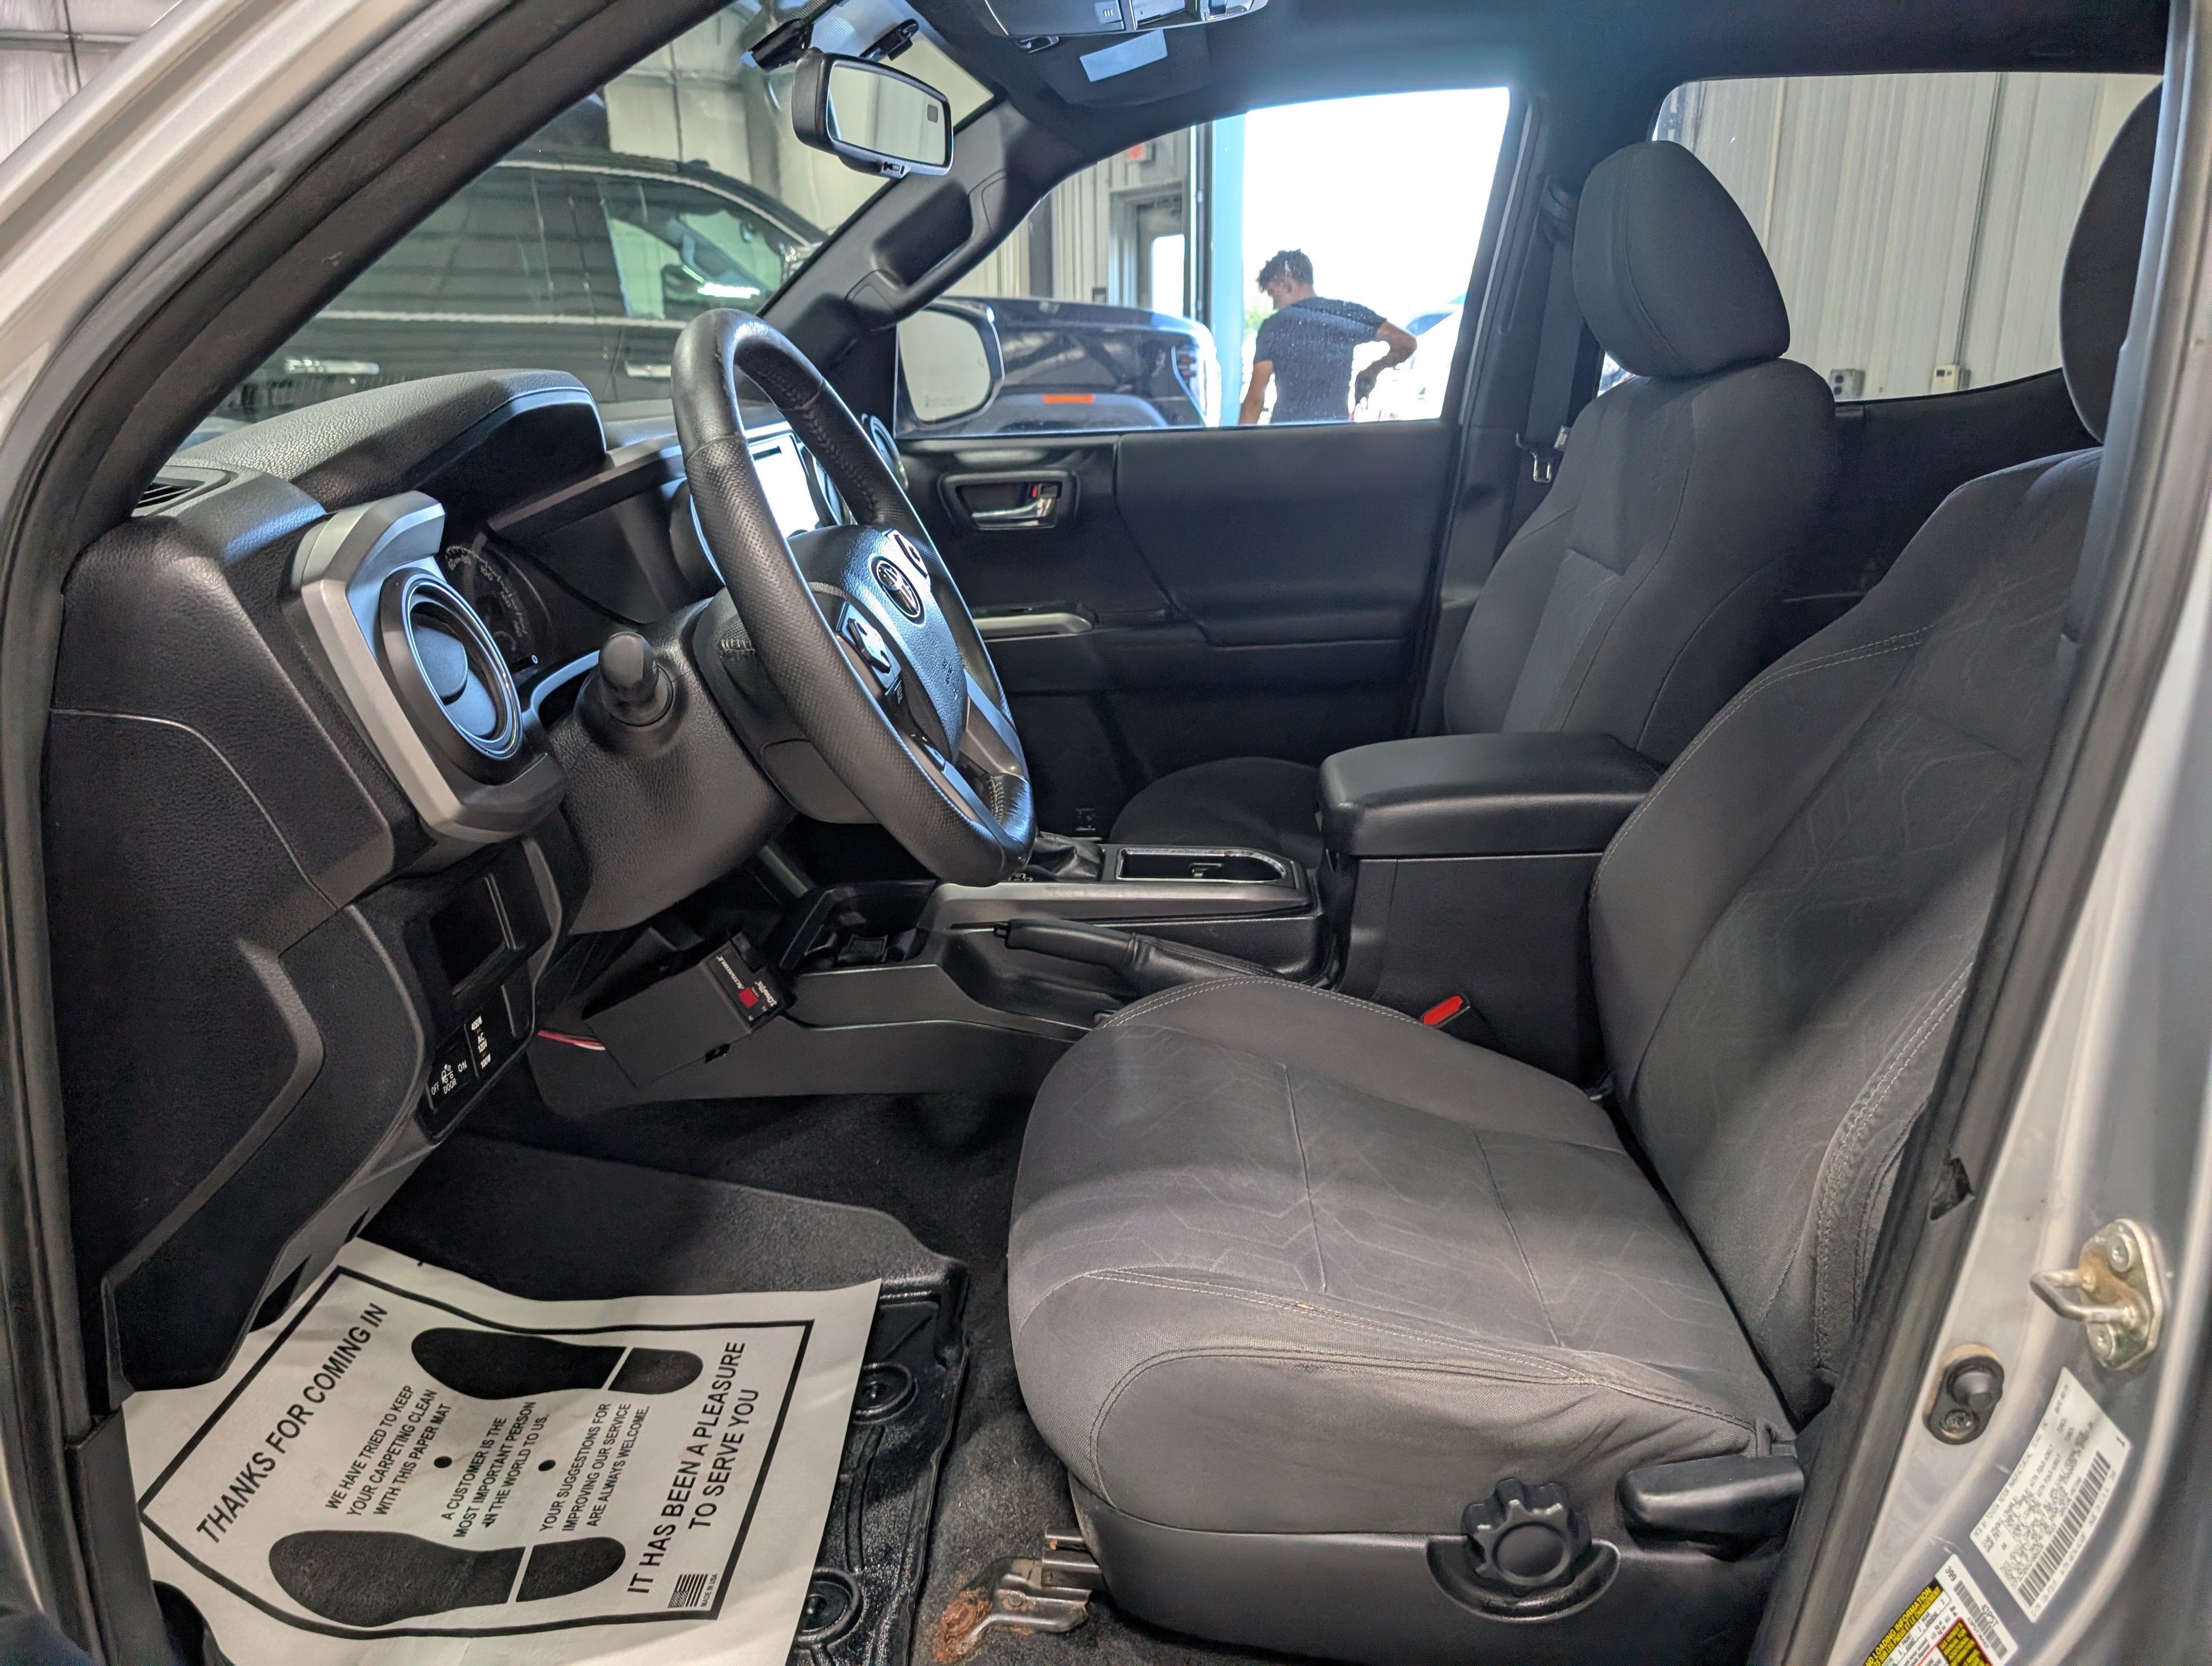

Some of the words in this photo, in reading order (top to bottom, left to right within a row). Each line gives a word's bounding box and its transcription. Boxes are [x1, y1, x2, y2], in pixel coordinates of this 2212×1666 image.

[478, 1032, 485, 1045] AC
[478, 1039, 487, 1053] 120V
[480, 1053, 491, 1069] 100W
[431, 1081, 439, 1095] OFF
[443, 1078, 456, 1094] DOOR
[458, 1060, 467, 1072] ON
[692, 1342, 745, 1439] PLEASURE
[196, 1452, 276, 1543] THANKS
[265, 1404, 314, 1454] FOR
[303, 1326, 371, 1404] COMING
[360, 1302, 388, 1328] IN
[325, 1490, 348, 1509] WE
[339, 1460, 367, 1490] HAVE
[358, 1428, 387, 1459] TRIED
[379, 1413, 397, 1427] TO
[390, 1385, 414, 1413] KEEP
[480, 1439, 495, 1449] IS
[486, 1417, 507, 1437] THE
[346, 1484, 378, 1515] YOUR
[369, 1424, 415, 1483] CARPETING
[408, 1389, 437, 1423] CLEAN
[374, 1487, 401, 1515] WITH
[392, 1461, 417, 1484] THIS
[409, 1425, 439, 1460] PAPER
[430, 1403, 451, 1424] MAT
[453, 1506, 480, 1537] MOST
[472, 1444, 513, 1503] IMPORTANT
[505, 1401, 536, 1441] PERSON
[488, 1489, 511, 1512] THE
[501, 1449, 531, 1487] WORLD
[523, 1433, 538, 1446] TO
[539, 1500, 565, 1532] YOUR
[557, 1426, 601, 1498] SUGGESTIONS
[592, 1404, 611, 1424] FOR
[562, 1472, 600, 1531] IMPROVING
[592, 1447, 612, 1470] OUR
[603, 1404, 631, 1445] SERVICE
[587, 1504, 607, 1527] ARE
[597, 1460, 626, 1502] ALWAYS
[617, 1406, 650, 1458] WELCOME.
[686, 1443, 709, 1456] A
[687, 1503, 717, 1529] TO
[702, 1432, 745, 1497] SERVE
[728, 1389, 759, 1427] YOU
[446, 1450, 488, 1509] CUSTOMER
[661, 1460, 702, 1517] BEEN
[441, 1512, 455, 1520] A
[639, 1524, 676, 1566] HAS
[627, 1573, 654, 1593] IT
[700, 1591, 712, 1607] MADE
[710, 1573, 718, 1584] USA
[1945, 1565, 1957, 1581] 399
[1872, 1629, 1896, 1658] LOADING
[1894, 1587, 1931, 1631] INFORMATION
